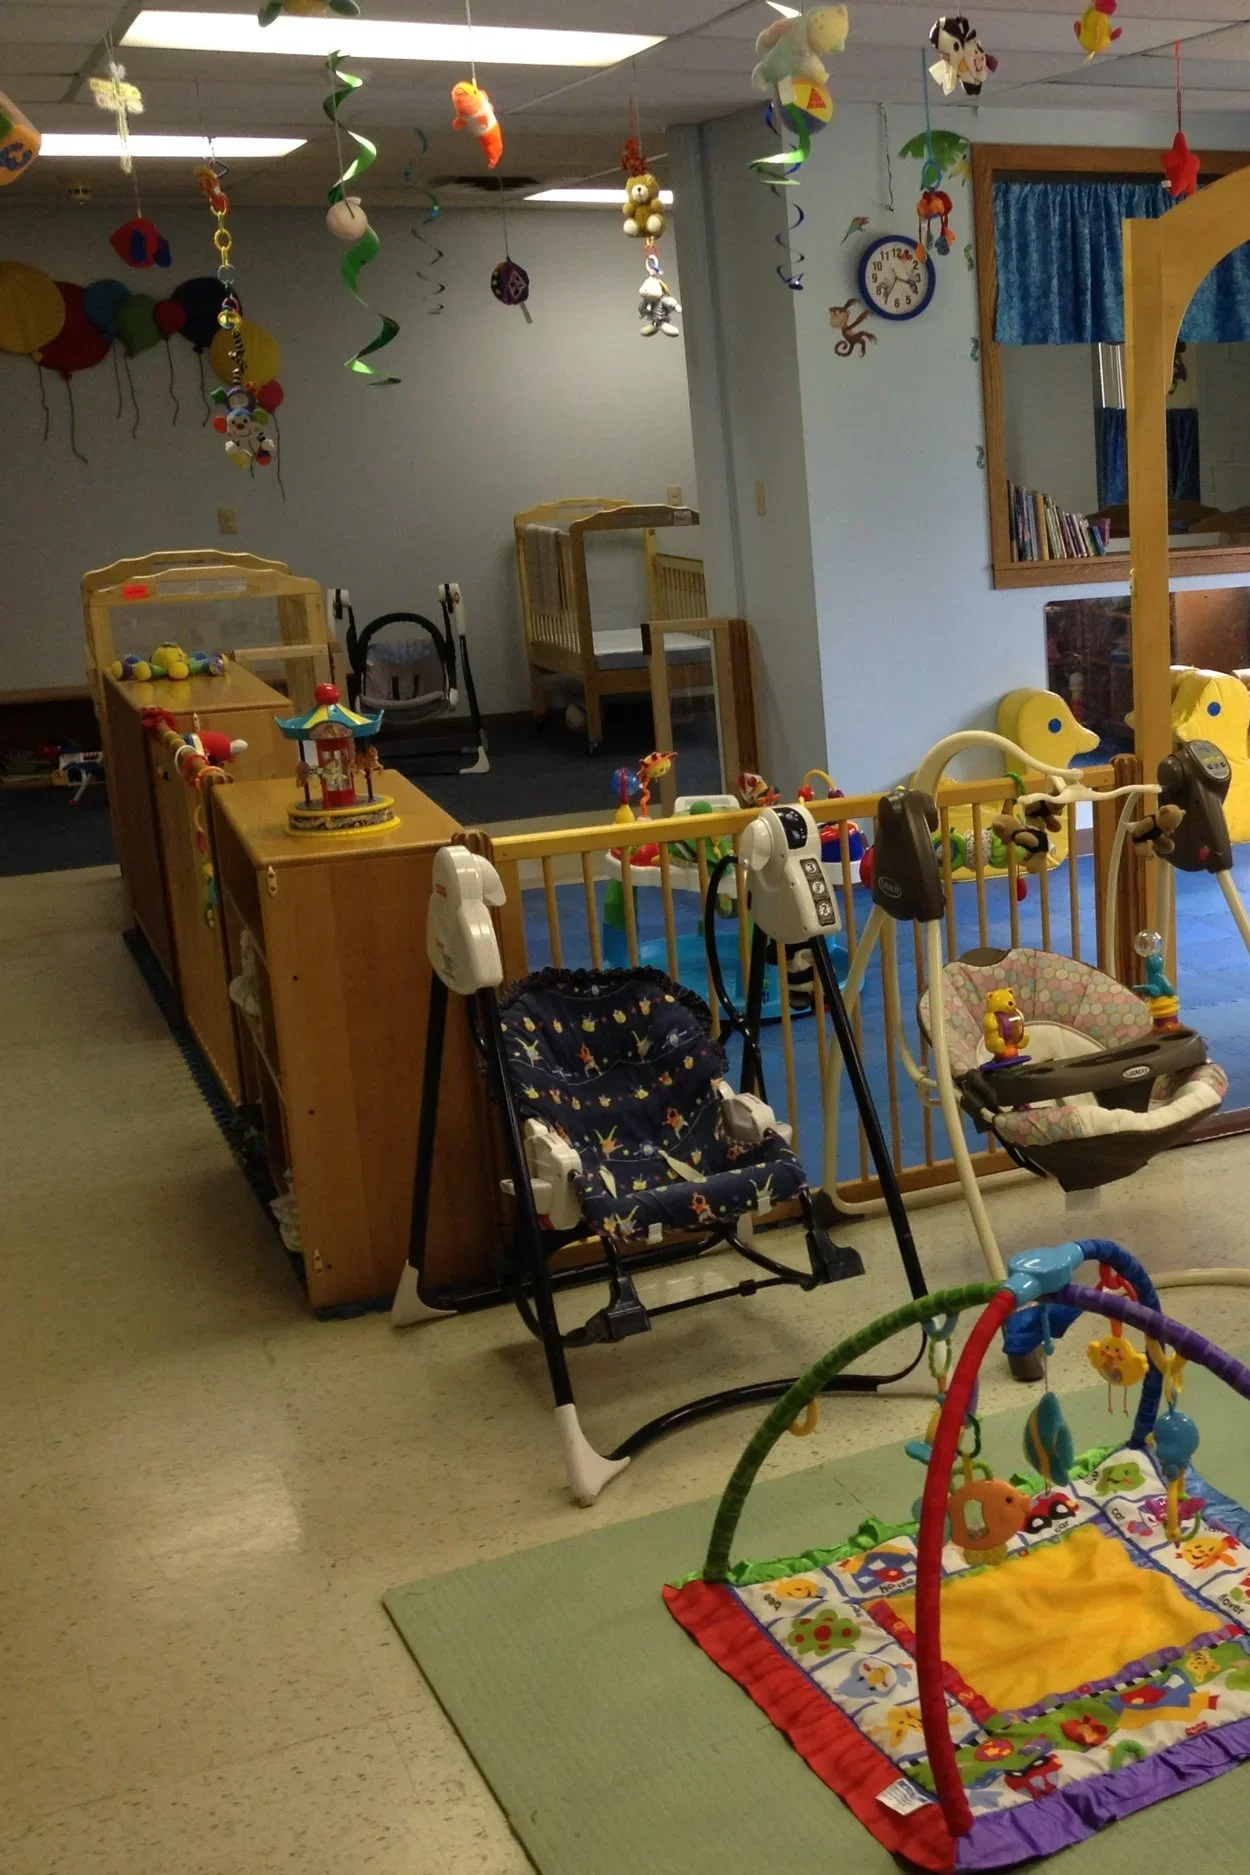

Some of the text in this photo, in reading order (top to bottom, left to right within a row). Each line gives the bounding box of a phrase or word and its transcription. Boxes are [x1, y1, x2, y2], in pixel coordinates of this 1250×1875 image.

[880, 251, 889, 261] 11
[892, 248, 902, 258] 12
[872, 261, 883, 271] 10
[912, 260, 919, 270] 2
[872, 273, 878, 283] 9
[915, 273, 921, 283] 3
[876, 285, 882, 296] 8
[894, 298, 900, 308] 6
[905, 295, 912, 305] 5
[1054, 1521, 1070, 1533] car
[763, 1594, 782, 1611] bee
